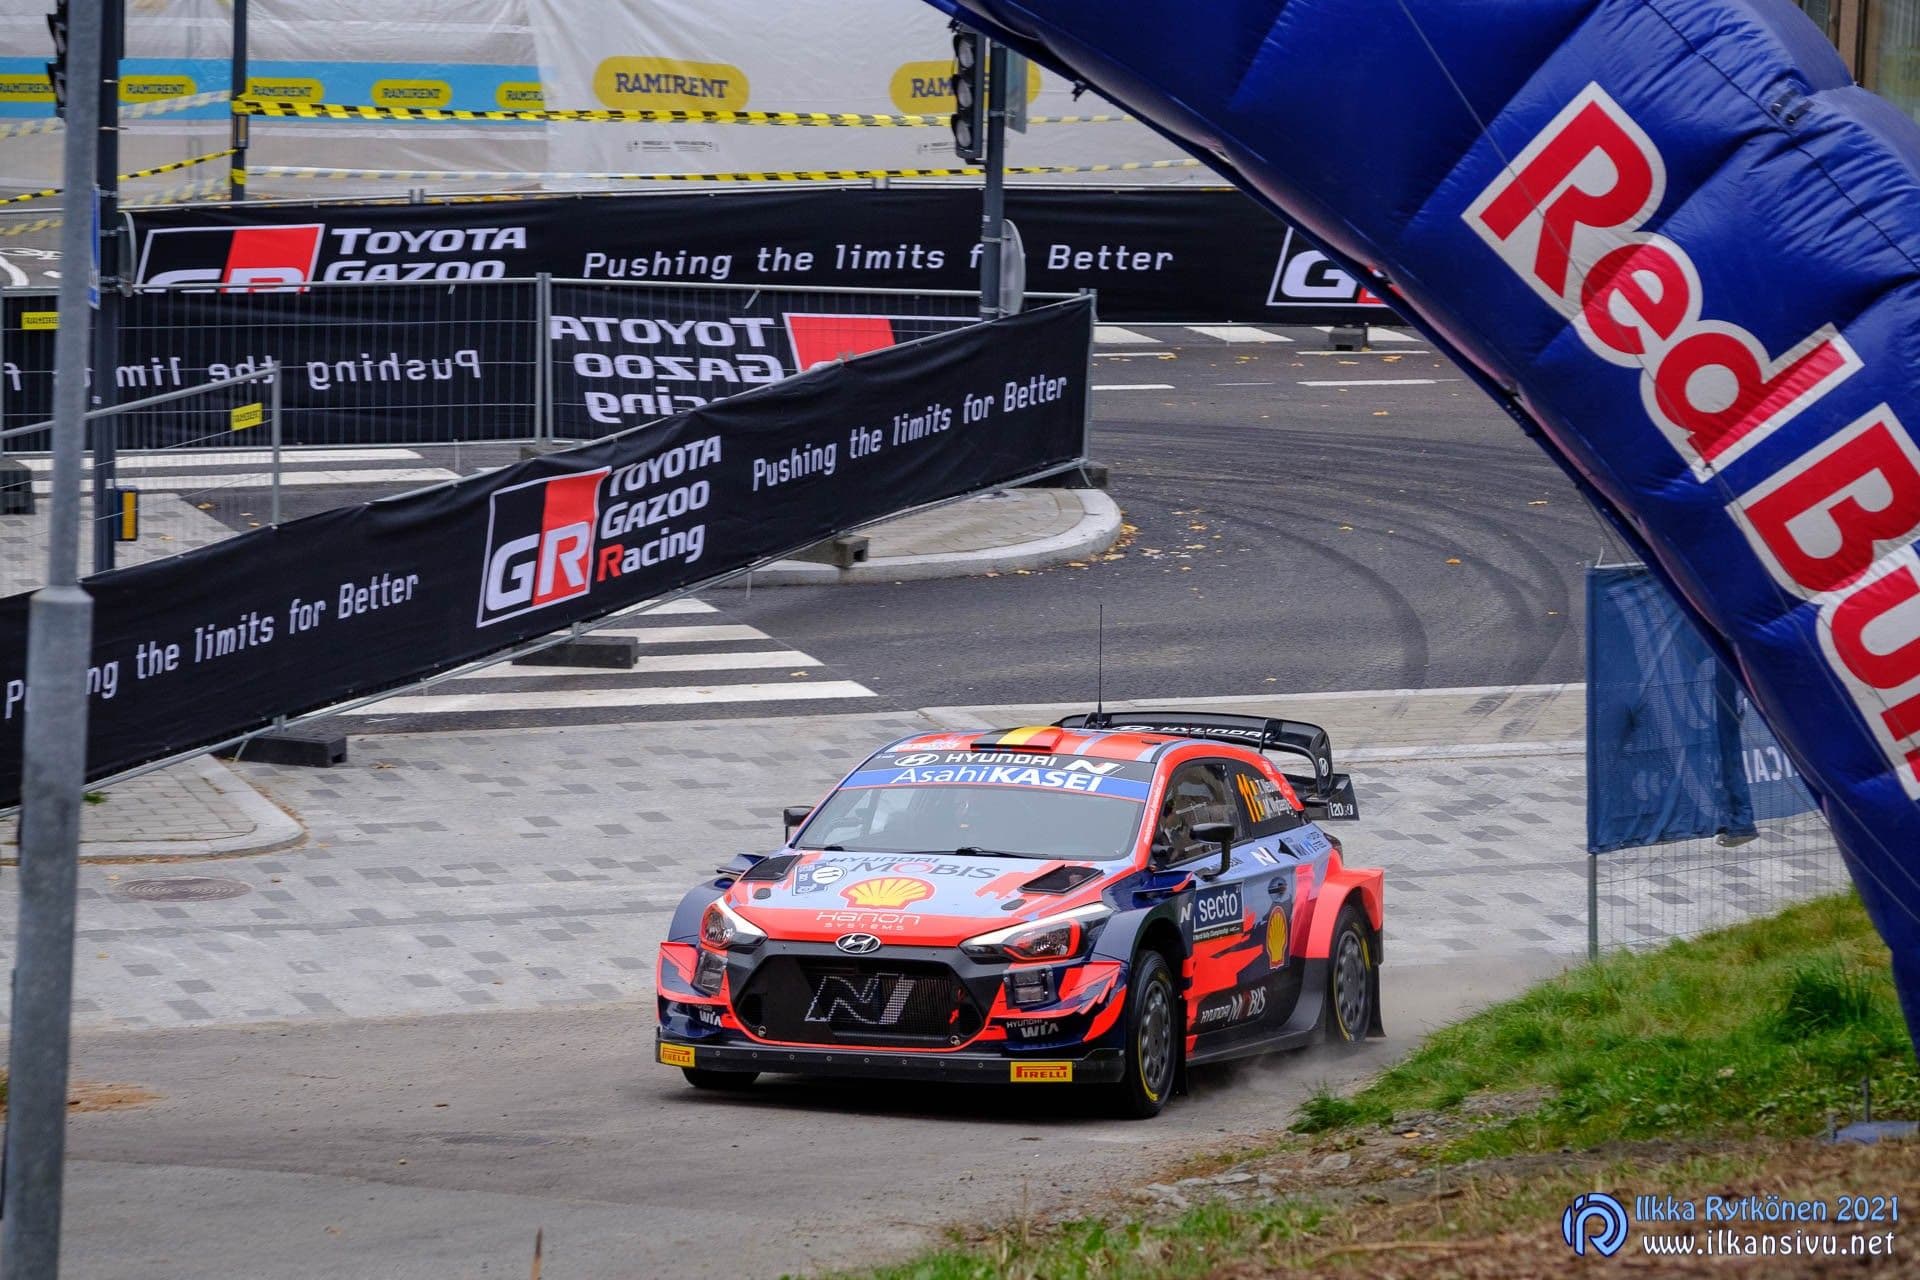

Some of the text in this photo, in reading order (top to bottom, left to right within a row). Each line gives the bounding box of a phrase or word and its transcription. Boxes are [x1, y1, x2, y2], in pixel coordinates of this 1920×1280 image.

[615, 72, 729, 98] RAMIRENT
[331, 227, 527, 255] TOYOTA
[324, 260, 506, 282] GAZOO
[583, 250, 732, 280] Pushing
[756, 247, 814, 273] the
[835, 243, 945, 270] limits
[1047, 243, 1174, 271] Better
[1475, 95, 1850, 467] Red
[752, 374, 1067, 492] Pushing the limits for Better
[608, 435, 721, 497] TOYOTA
[601, 480, 710, 539] GAZOO
[486, 521, 592, 611] GR
[596, 525, 706, 582] Racing
[136, 572, 419, 681] the limits for Better
[945, 753, 1058, 766] HYUNDAI
[849, 862, 1001, 879] MOBIS
[1198, 888, 1238, 923] secto
[824, 921, 905, 932] SYSTEMS
[1015, 1065, 1068, 1079] PIRELLI
